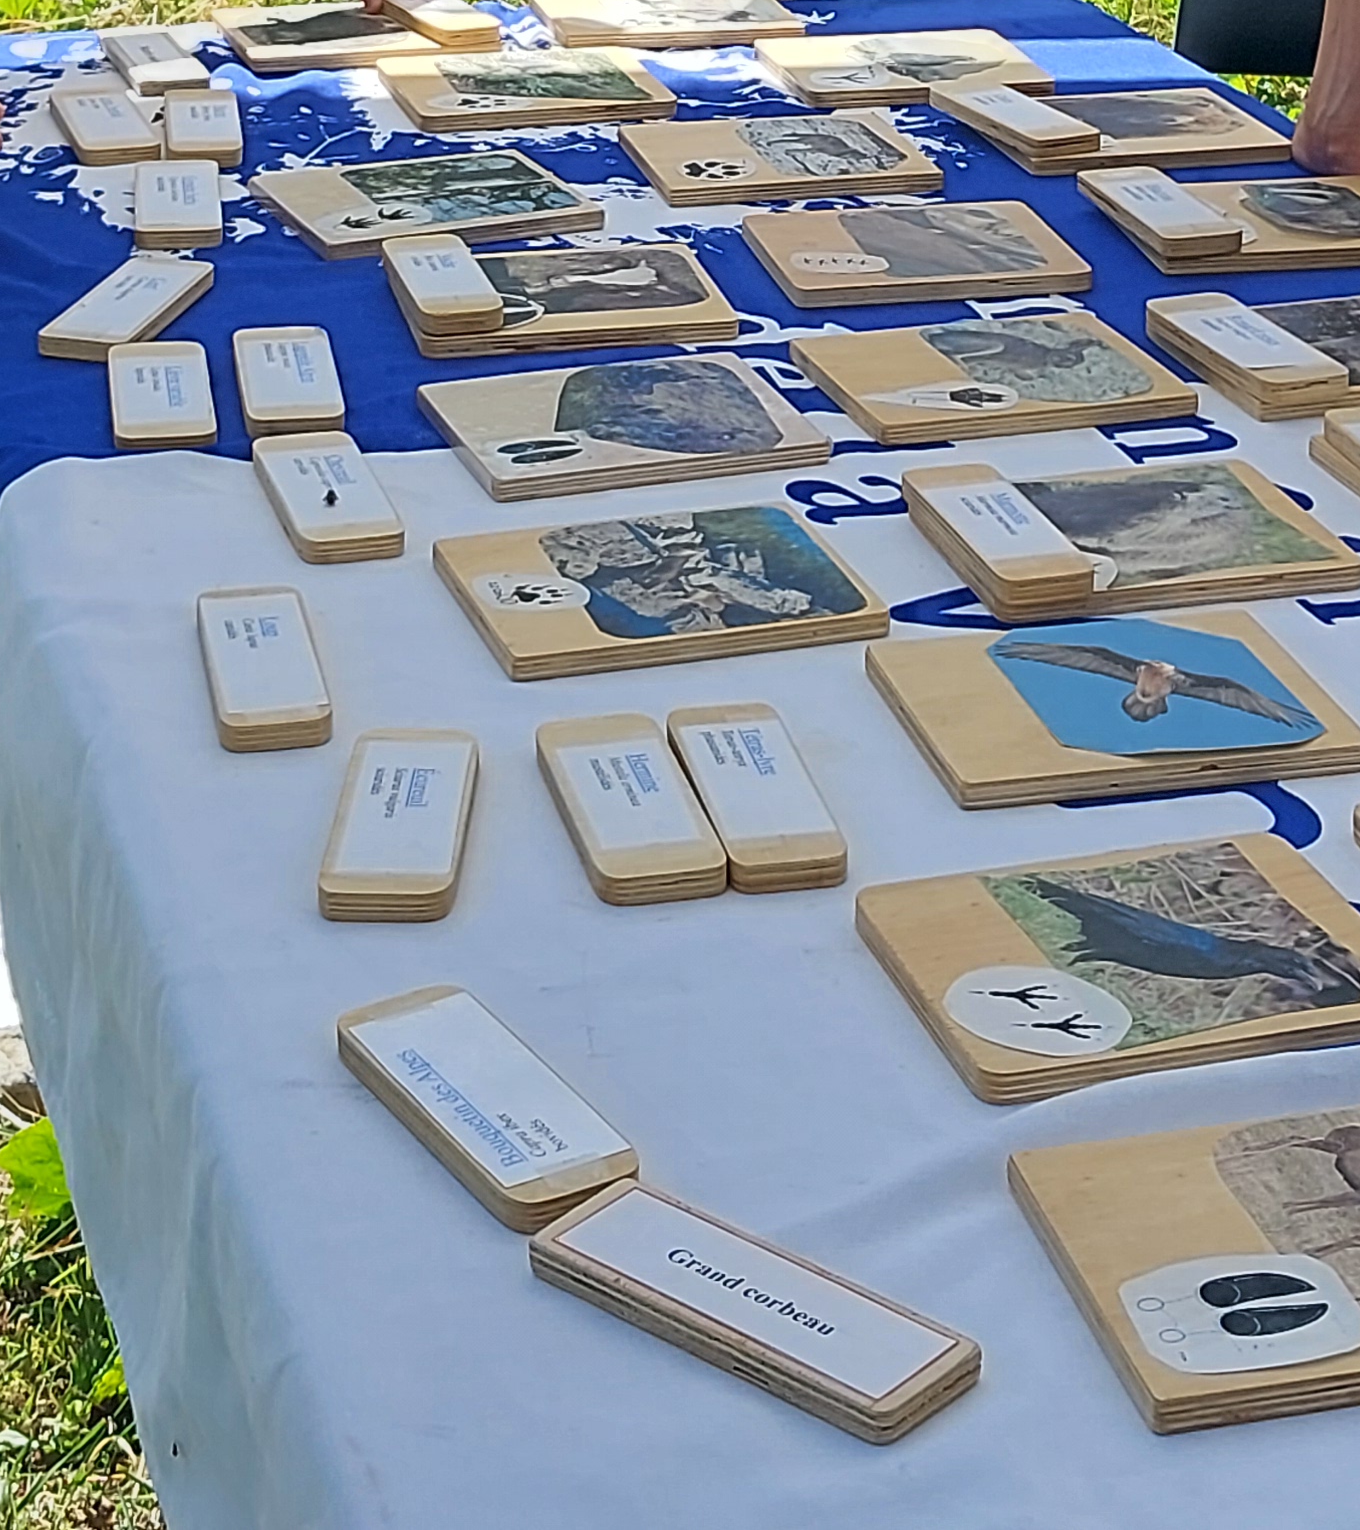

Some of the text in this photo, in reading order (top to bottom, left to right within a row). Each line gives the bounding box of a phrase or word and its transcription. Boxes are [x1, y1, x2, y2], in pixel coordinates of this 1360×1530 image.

[626, 753, 660, 793] Hermine
[397, 1048, 528, 1168] Bouquetin des Alpes
[514, 1130, 547, 1158] Capra
[667, 1248, 836, 1337] Grand corbeau
